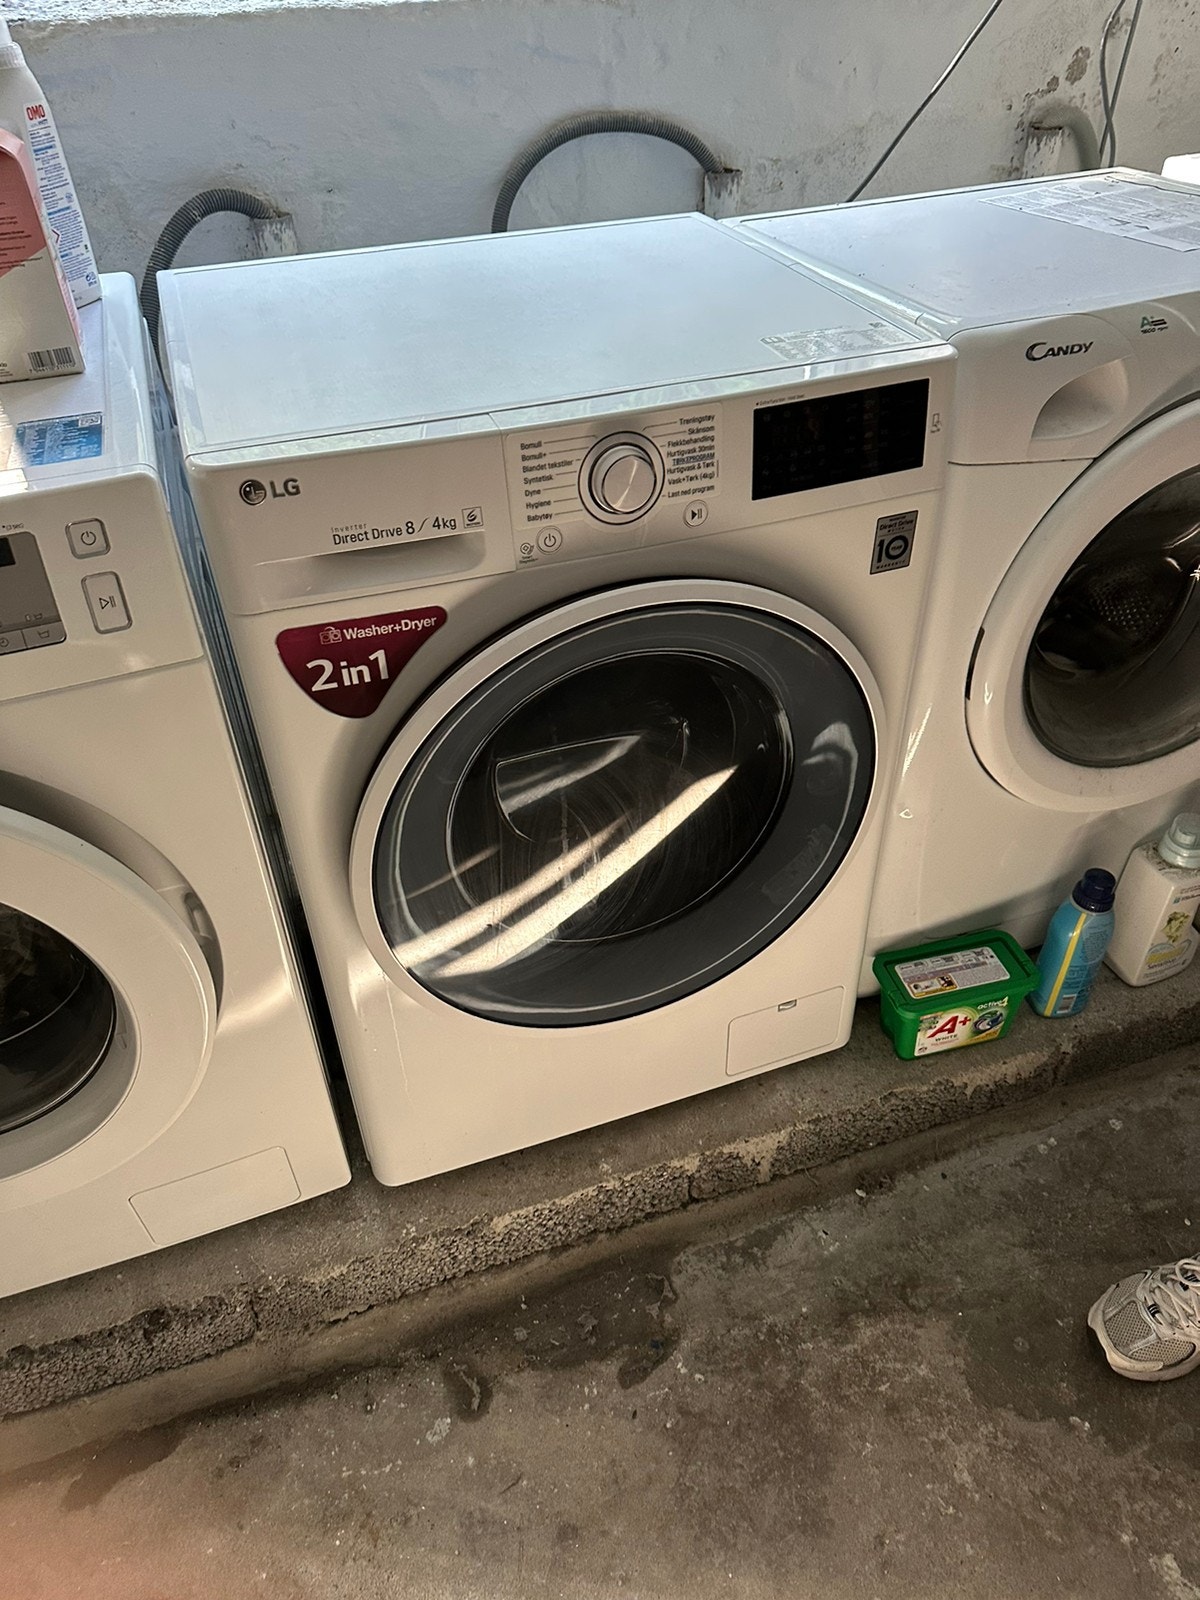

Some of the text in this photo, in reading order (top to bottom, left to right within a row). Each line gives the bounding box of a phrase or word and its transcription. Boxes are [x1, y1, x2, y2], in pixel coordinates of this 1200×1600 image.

[26, 104, 46, 121] OMO
[1025, 341, 1095, 362] CANDY
[679, 414, 716, 426] Treningstøy
[688, 425, 716, 435] Skånsom
[520, 440, 543, 451] Bomull
[667, 435, 716, 448] Flekkbehandling
[521, 452, 547, 462] Bomull+
[667, 447, 697, 459] Hurtigvask
[522, 459, 574, 473] Blandet tekstiler
[667, 464, 697, 475] Hurtigvask
[702, 461, 716, 469] Tørk
[523, 474, 554, 485] Syntetisk
[269, 478, 301, 499] LG
[524, 487, 542, 498] Dyne
[668, 484, 716, 499] Last ned program
[525, 499, 552, 510] Hygiene
[527, 512, 553, 523] Babytøy
[332, 529, 370, 546] Direct
[371, 526, 403, 541] Drive
[877, 535, 909, 563] 10
[343, 616, 438, 641] Washer+Dryer
